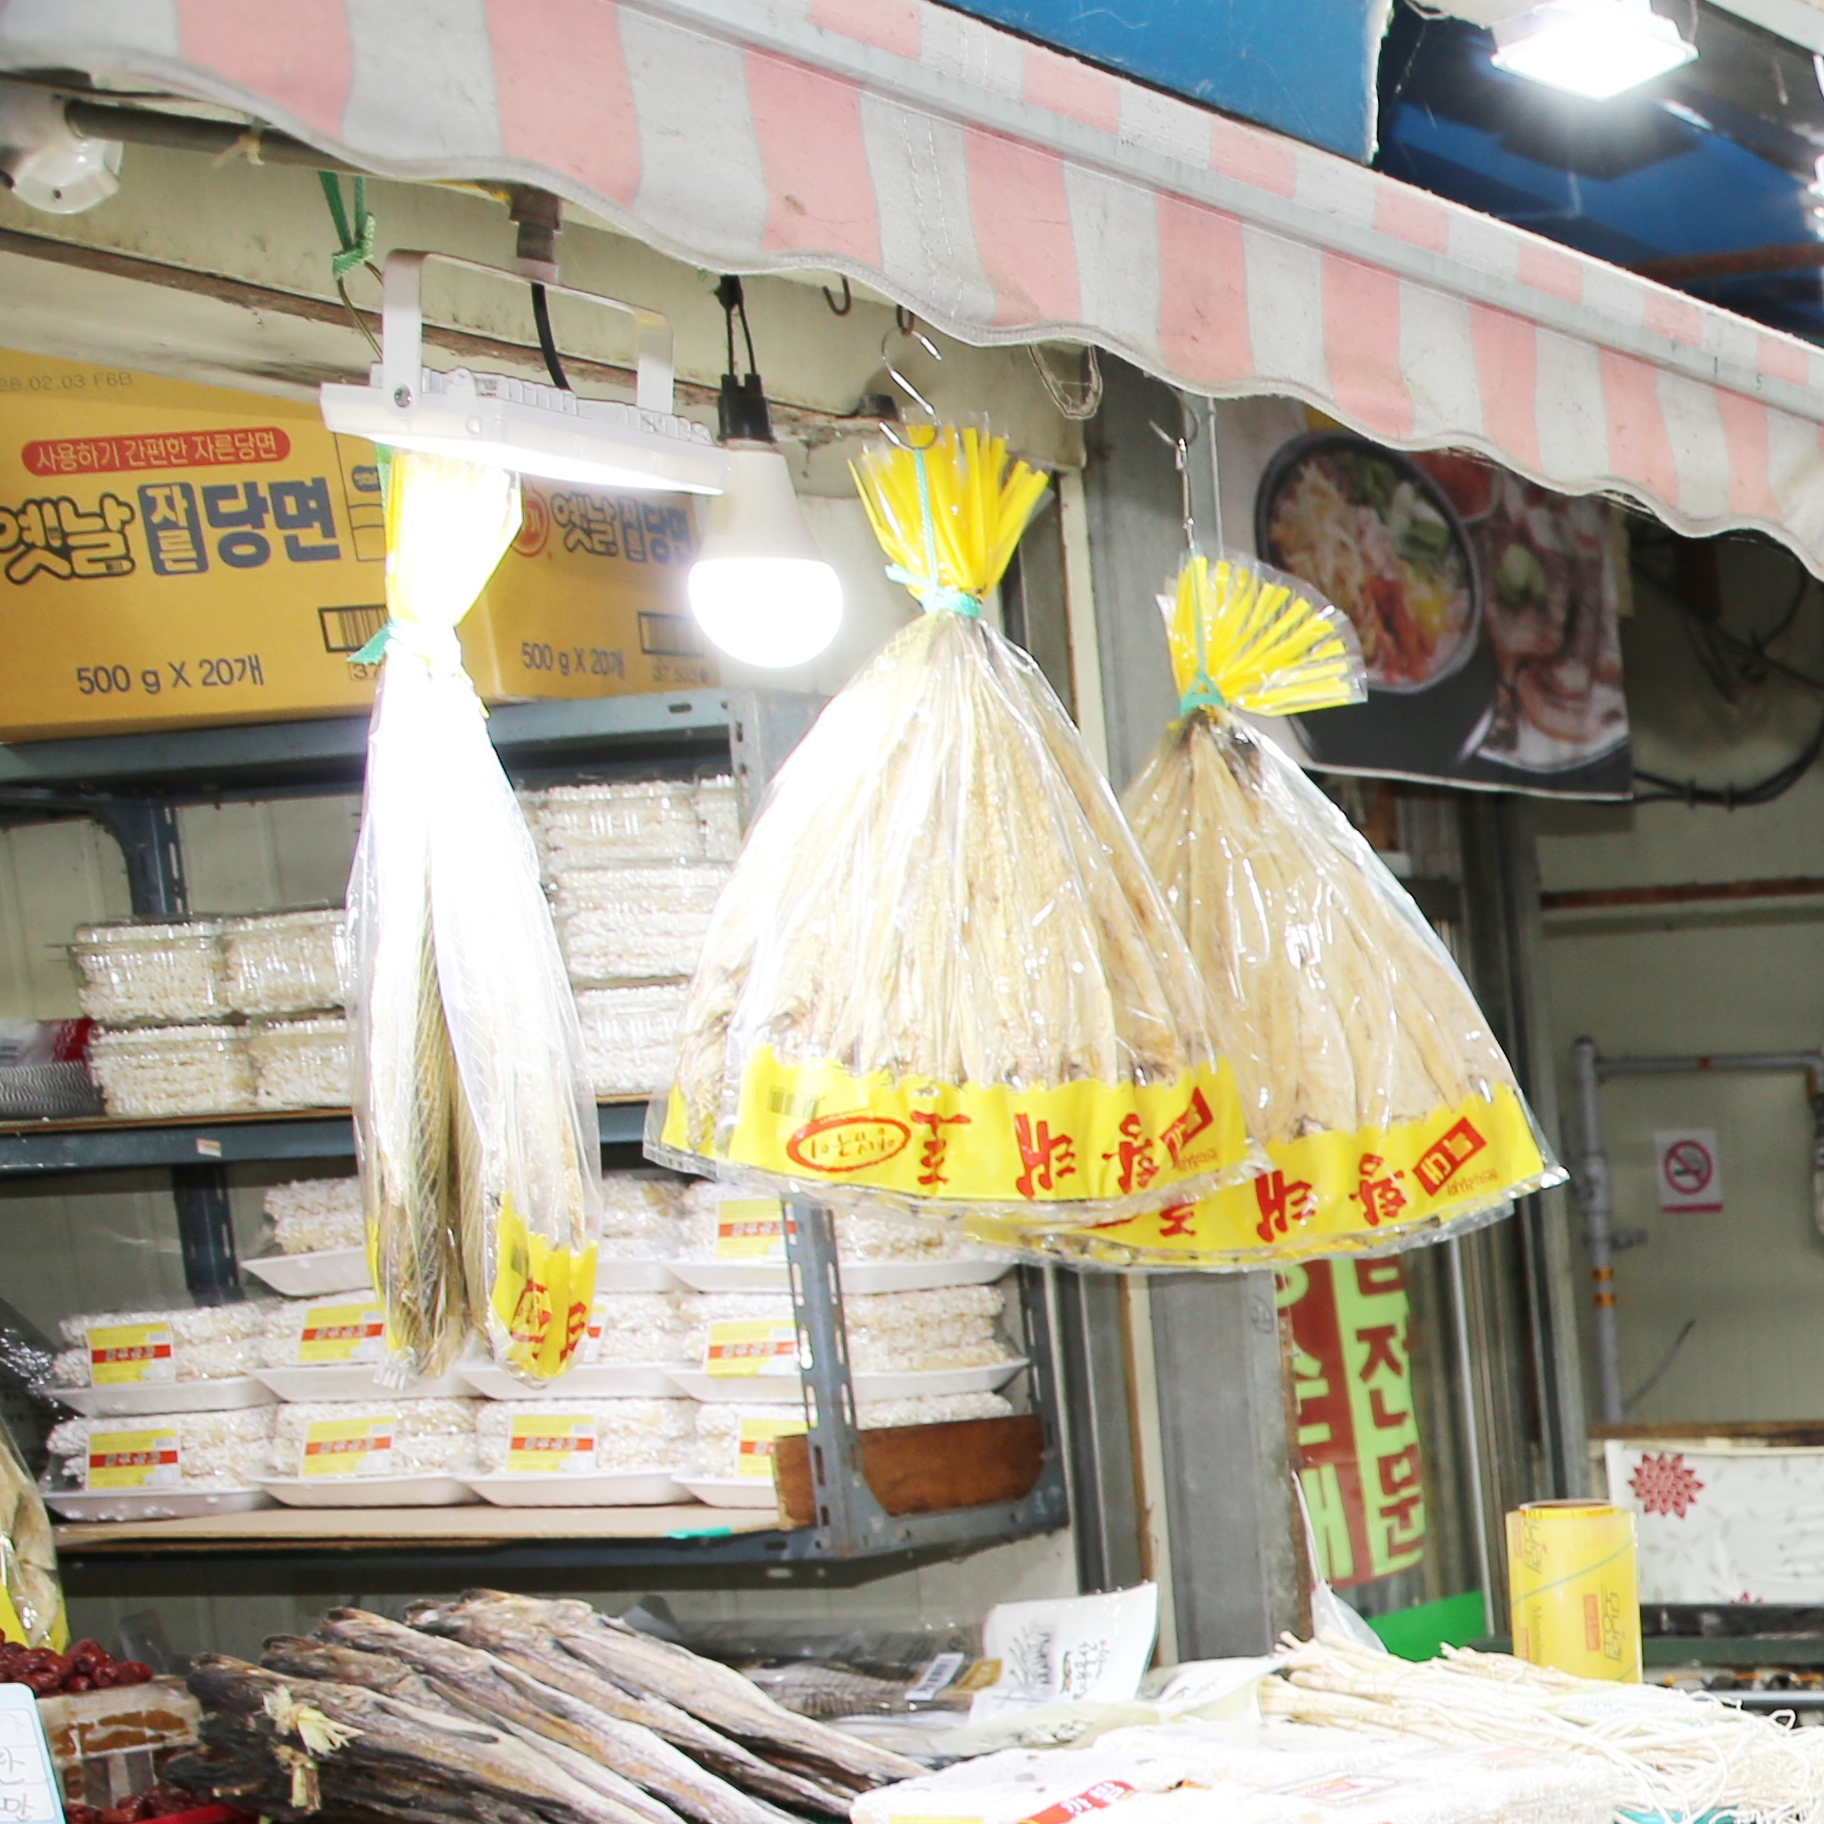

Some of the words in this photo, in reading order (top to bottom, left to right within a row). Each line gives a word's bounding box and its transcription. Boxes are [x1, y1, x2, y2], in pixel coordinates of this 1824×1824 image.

[36, 440, 121, 473] 사용하기
[124, 435, 189, 467] 간편한
[191, 430, 278, 464] 자른당면
[76, 665, 130, 694] 500
[141, 670, 161, 694] g
[199, 653, 265, 686] 20개
[521, 642, 553, 671] 500
[910, 1110, 1161, 1199] 황태포
